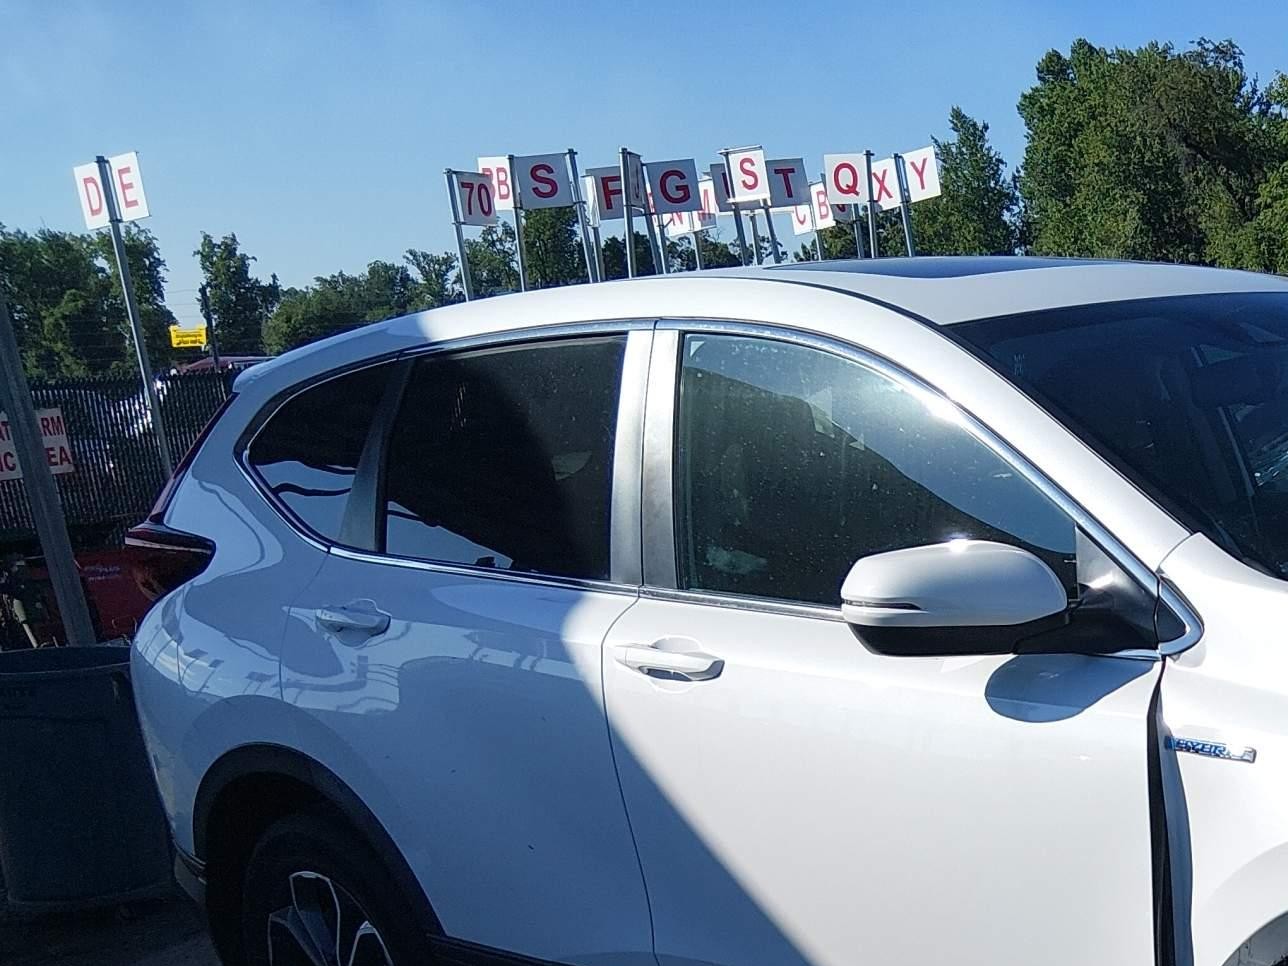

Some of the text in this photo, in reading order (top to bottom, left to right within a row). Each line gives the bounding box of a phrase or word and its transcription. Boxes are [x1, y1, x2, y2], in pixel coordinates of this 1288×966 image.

[118, 167, 139, 208] E
[530, 164, 559, 199] S
[660, 170, 691, 204] G
[740, 158, 759, 191] S
[774, 168, 796, 198] T
[834, 163, 860, 196] Q
[872, 169, 893, 203] X
[910, 158, 927, 190] Y
[83, 177, 103, 216] D
[460, 182, 493, 217] 70
[601, 175, 623, 210] F
[816, 190, 830, 220] B
